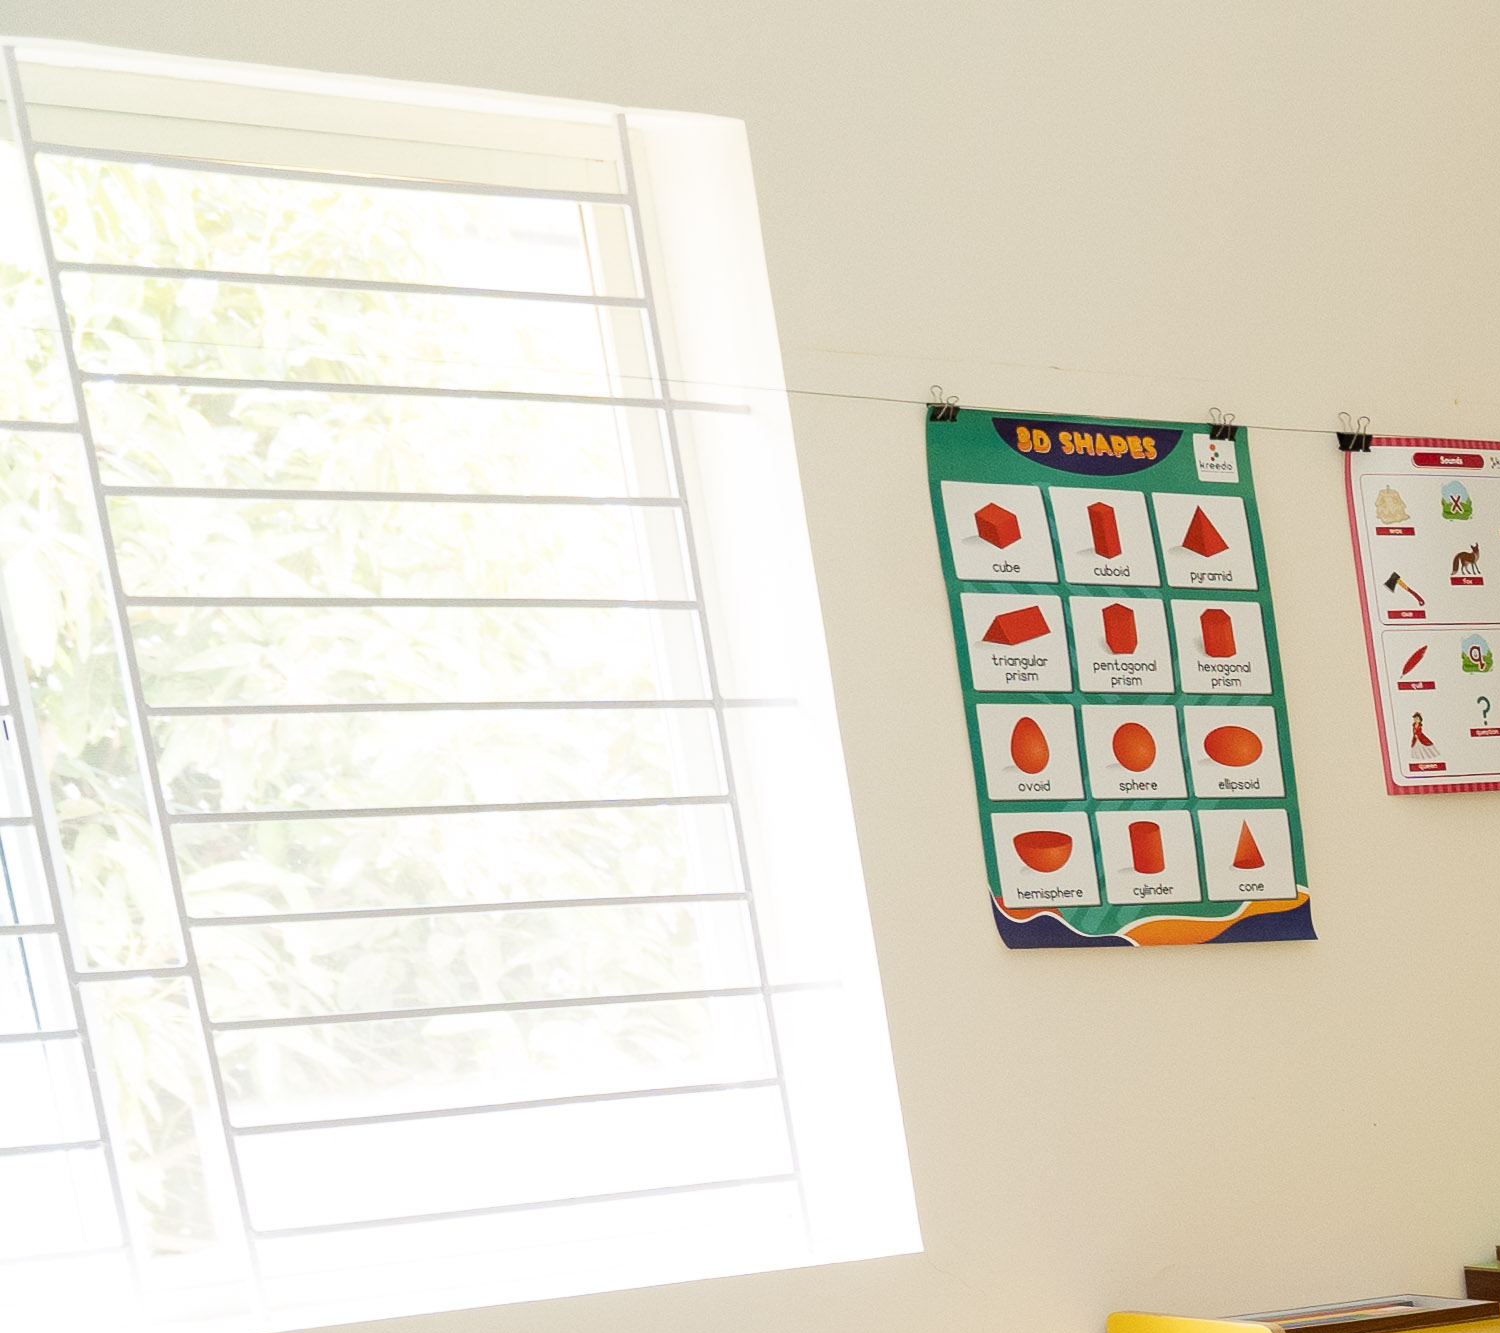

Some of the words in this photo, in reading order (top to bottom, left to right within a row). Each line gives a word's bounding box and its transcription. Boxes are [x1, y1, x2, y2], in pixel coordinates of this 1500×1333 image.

[1016, 426, 1051, 453] 3D
[1059, 432, 1157, 459] SHAPES
[1200, 460, 1233, 471] kreedo
[1440, 456, 1463, 465] Sounds
[1450, 495, 1462, 512] x
[992, 561, 1021, 573] cube
[1094, 565, 1130, 577] cuboid
[1190, 570, 1232, 583] pyramid
[992, 654, 1048, 668] triangular
[1470, 646, 1485, 670] q
[1093, 660, 1157, 674] pentagonal
[1198, 661, 1251, 675] hexagonal
[1006, 671, 1038, 683] prism
[1111, 675, 1142, 687] prism
[1211, 676, 1241, 688] prism
[1018, 781, 1051, 792] ovoid
[1119, 780, 1157, 793] sphere
[1219, 779, 1260, 791] ellipsoid
[1133, 885, 1174, 897] cylinder
[1239, 882, 1264, 892] cone
[1017, 887, 1083, 901] hemisphere
